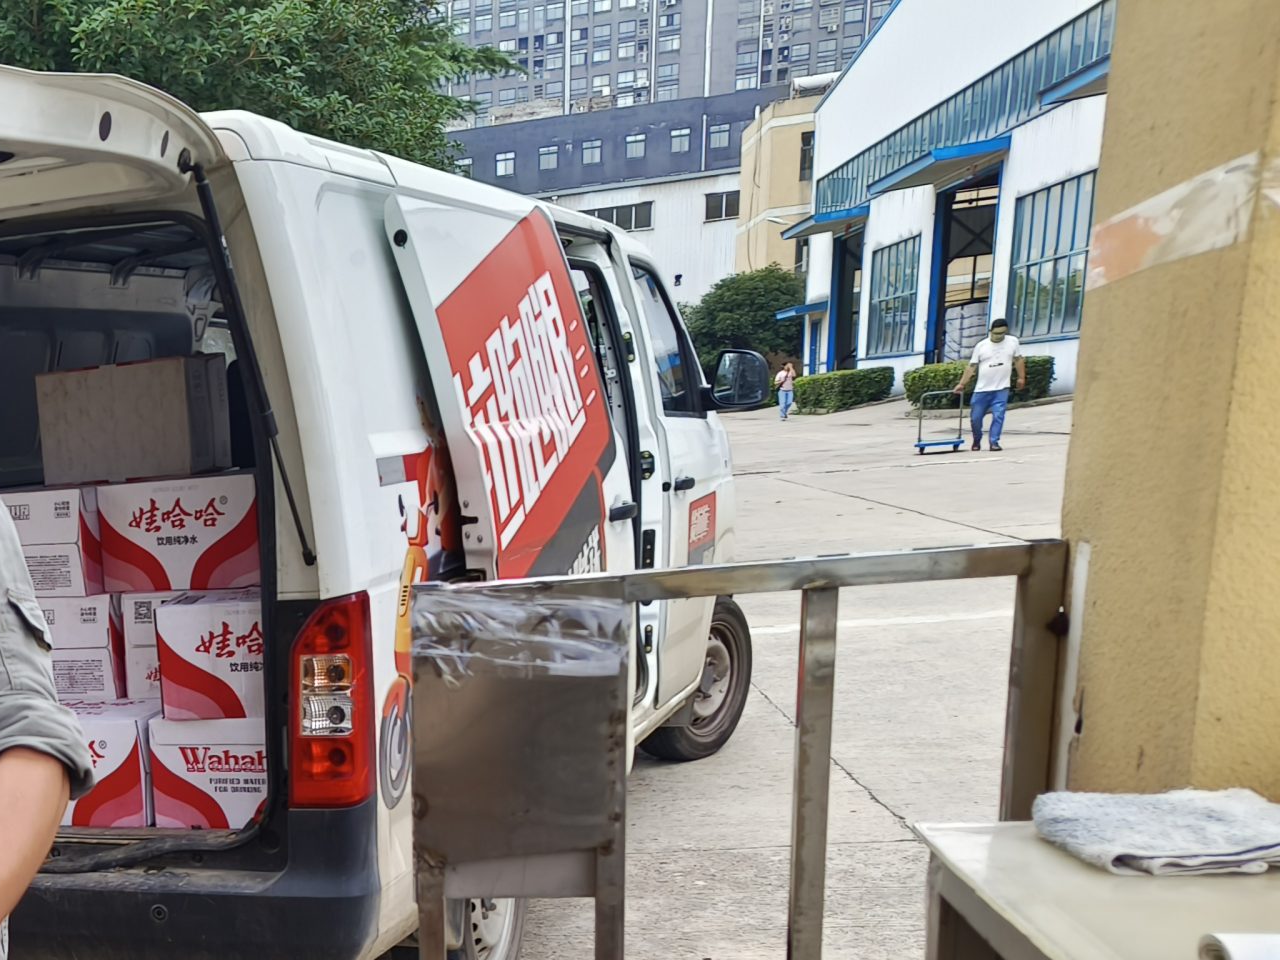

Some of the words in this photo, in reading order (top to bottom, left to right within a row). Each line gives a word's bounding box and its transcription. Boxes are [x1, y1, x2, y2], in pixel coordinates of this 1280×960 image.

[128, 497, 225, 532] 娃哈哈
[157, 535, 198, 546] 饮用纯净水
[230, 662, 263, 673] 饮用纯
